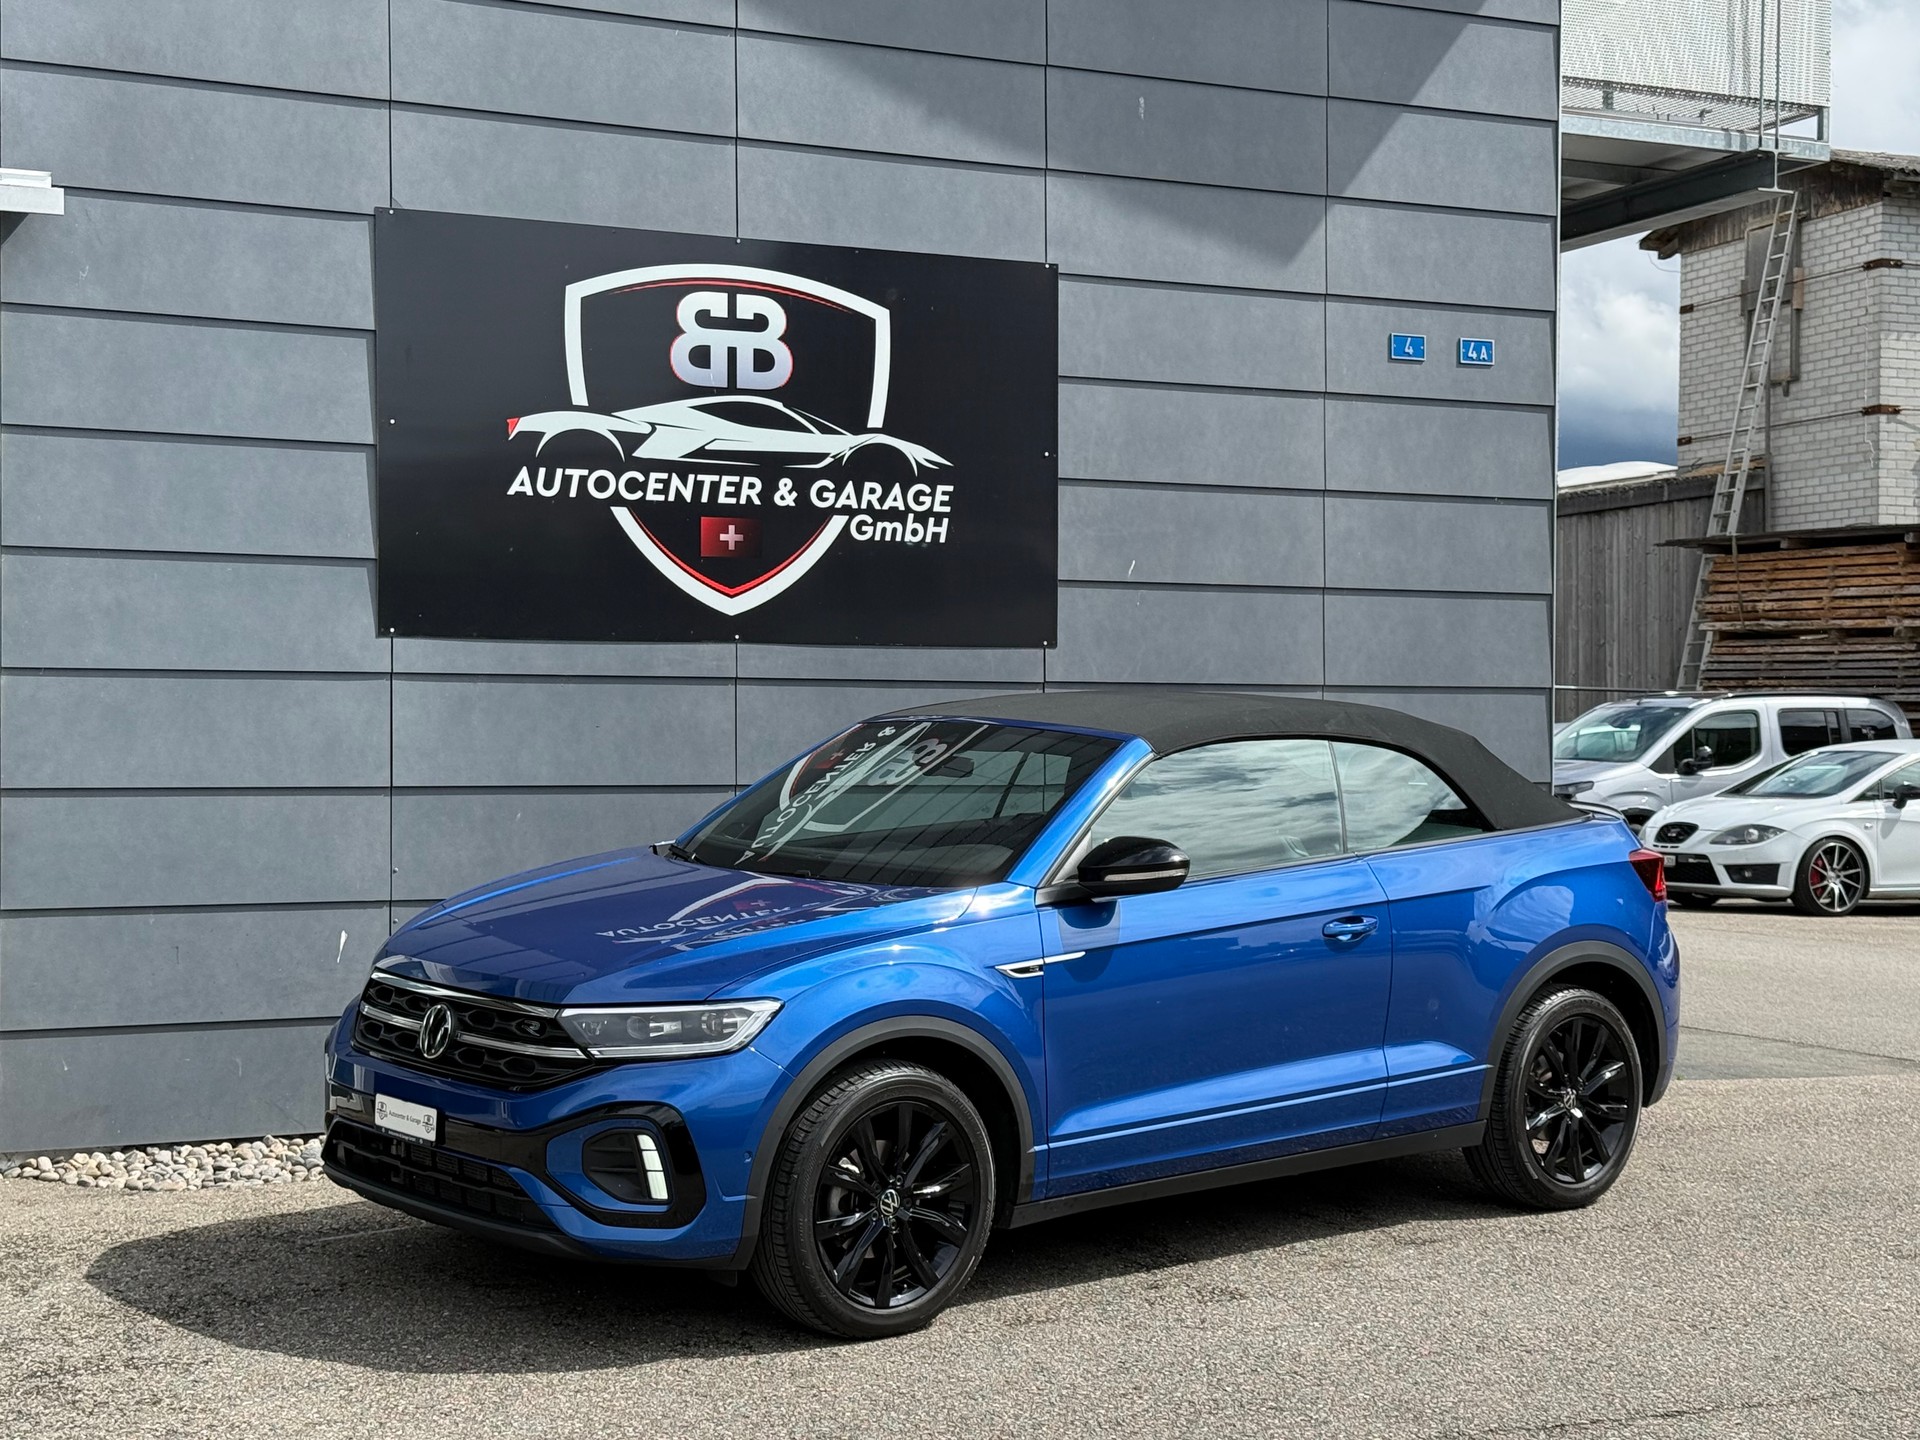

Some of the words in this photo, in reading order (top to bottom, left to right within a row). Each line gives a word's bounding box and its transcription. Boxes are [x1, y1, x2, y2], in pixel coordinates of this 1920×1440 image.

[1404, 337, 1414, 356] 4
[1467, 342, 1488, 360] 4A
[506, 465, 763, 506] AUTOCENTER
[773, 477, 798, 507] &
[809, 479, 954, 513] GARAGE
[849, 512, 949, 544] GmbH
